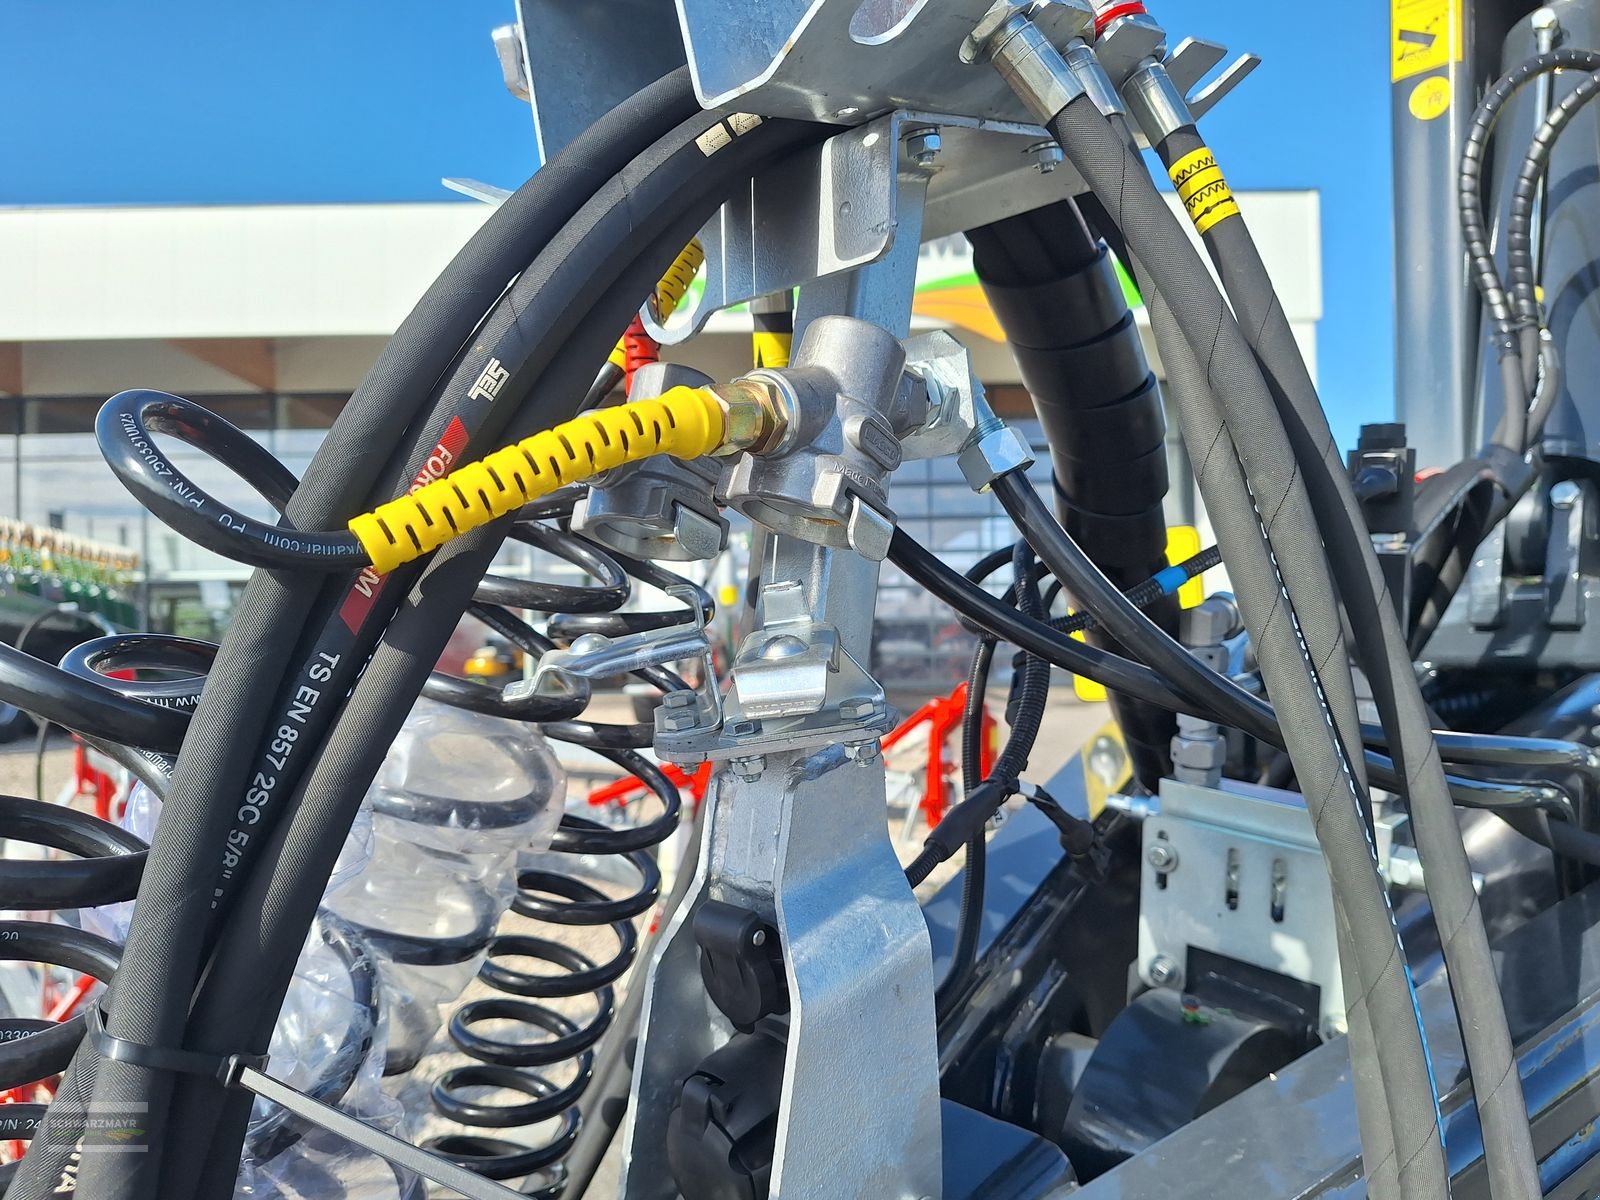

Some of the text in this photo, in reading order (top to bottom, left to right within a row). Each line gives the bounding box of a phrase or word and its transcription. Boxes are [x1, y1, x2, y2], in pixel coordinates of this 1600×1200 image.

[467, 357, 511, 402] SEL
[308, 651, 341, 682] TS
[286, 685, 321, 724] EN
[265, 724, 299, 771] 857
[237, 772, 276, 825] 2SC
